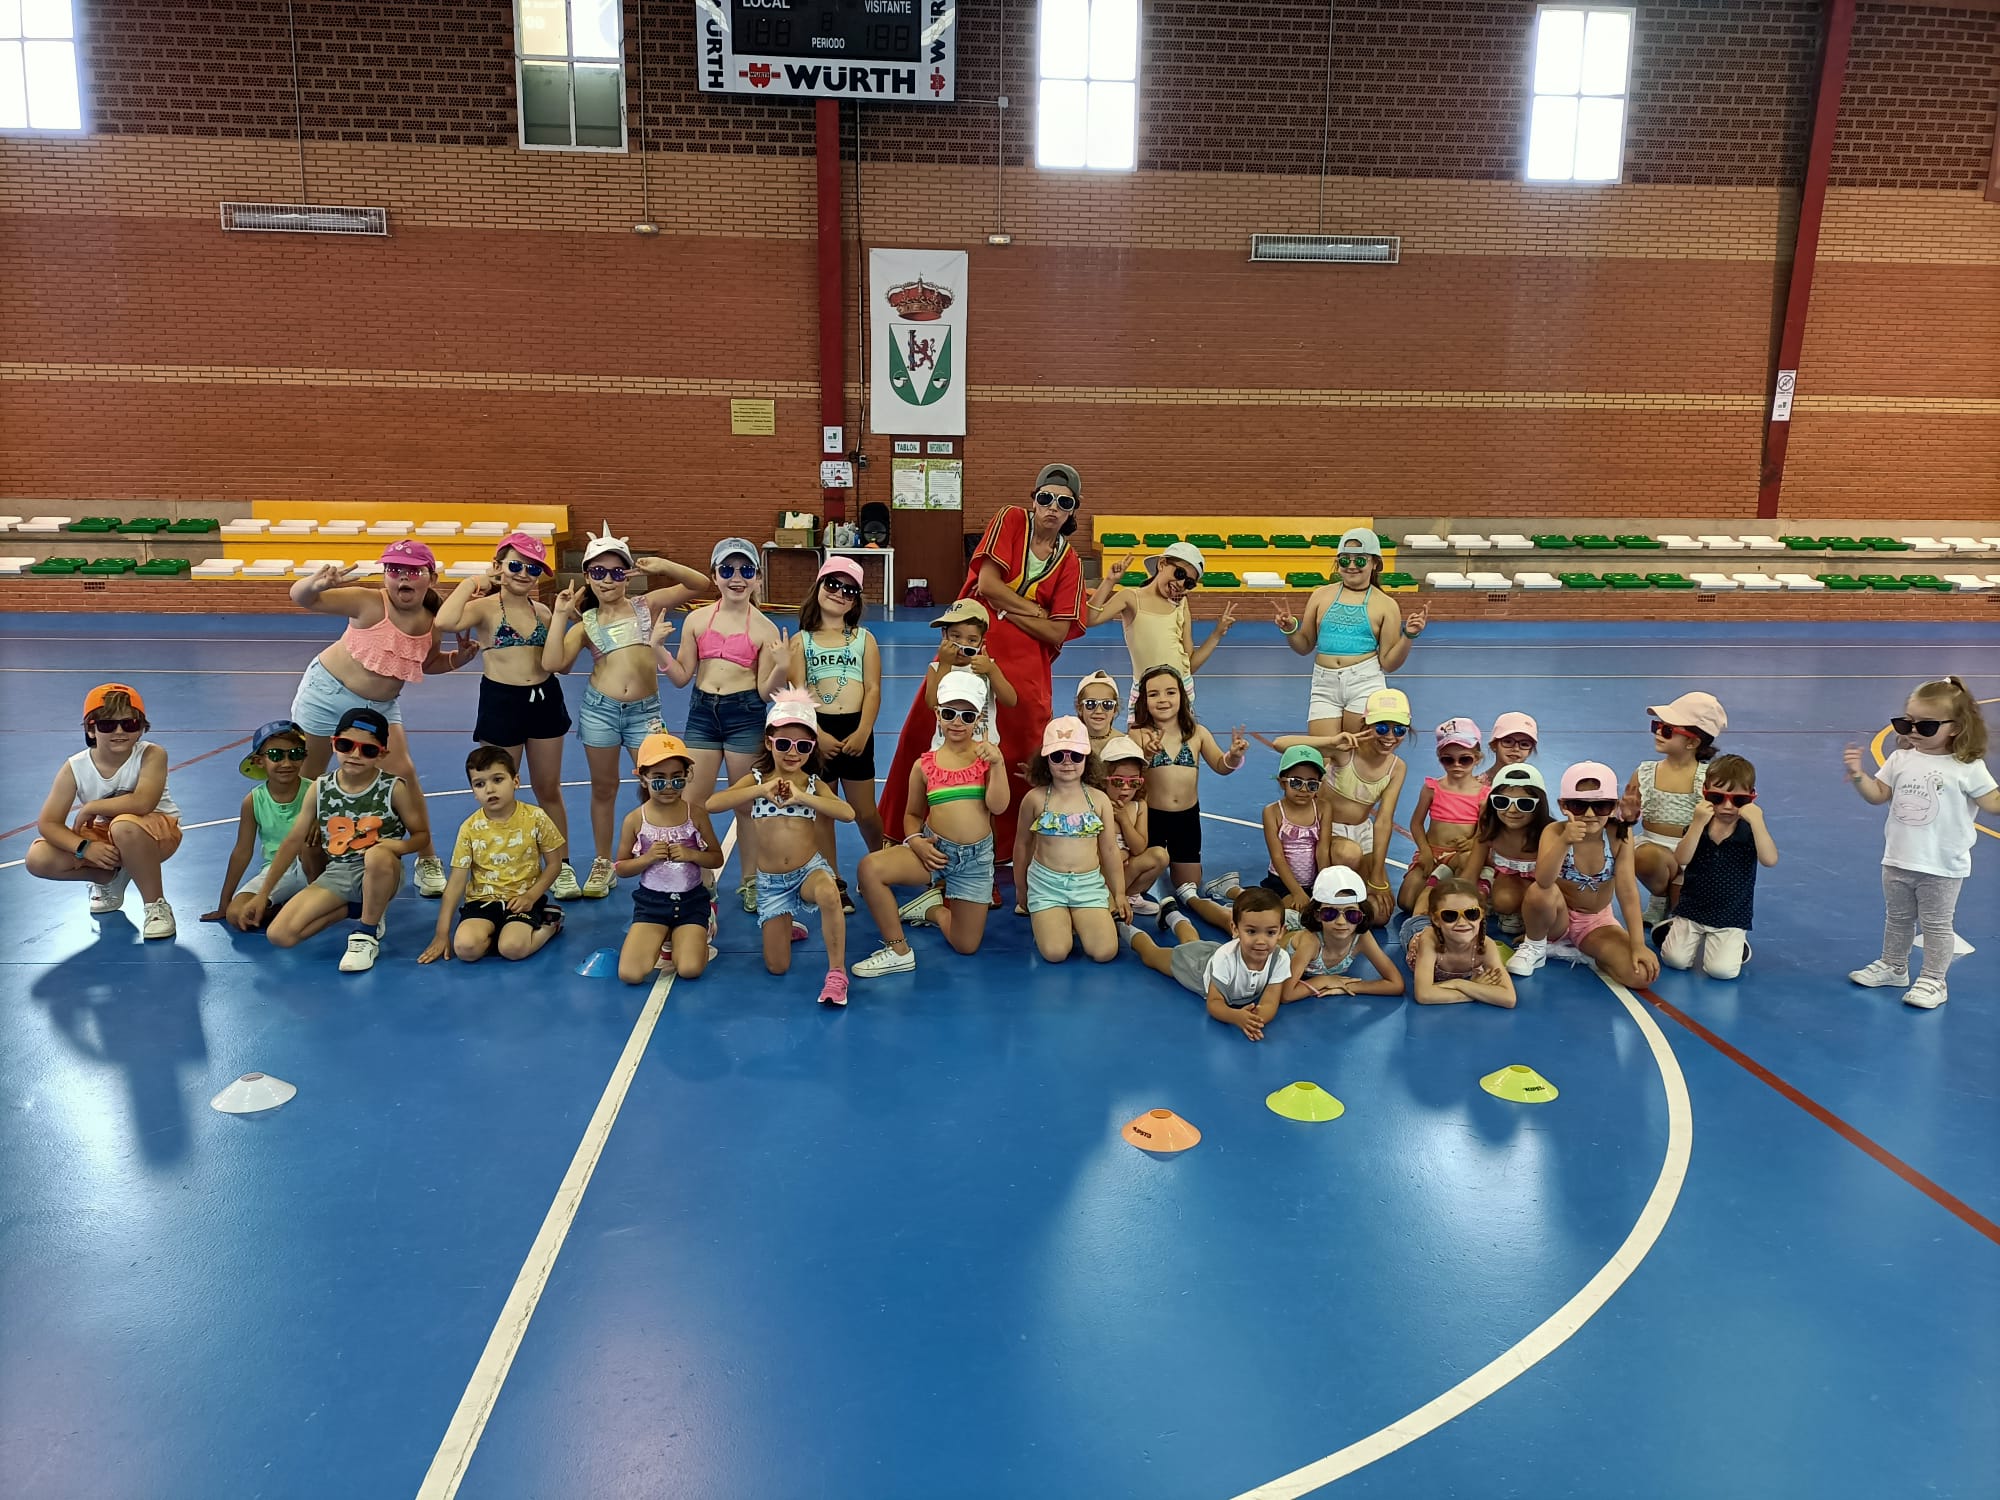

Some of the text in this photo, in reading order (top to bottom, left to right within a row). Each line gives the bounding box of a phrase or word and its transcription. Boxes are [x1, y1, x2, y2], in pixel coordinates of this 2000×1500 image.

[743, 0, 790, 8] LOCAL
[865, 0, 911, 13] VISITANTE
[706, 0, 724, 88] ÜRTH
[811, 37, 845, 48] PERIODO
[784, 64, 916, 94] WÜRTH
[812, 654, 857, 667] DREAM
